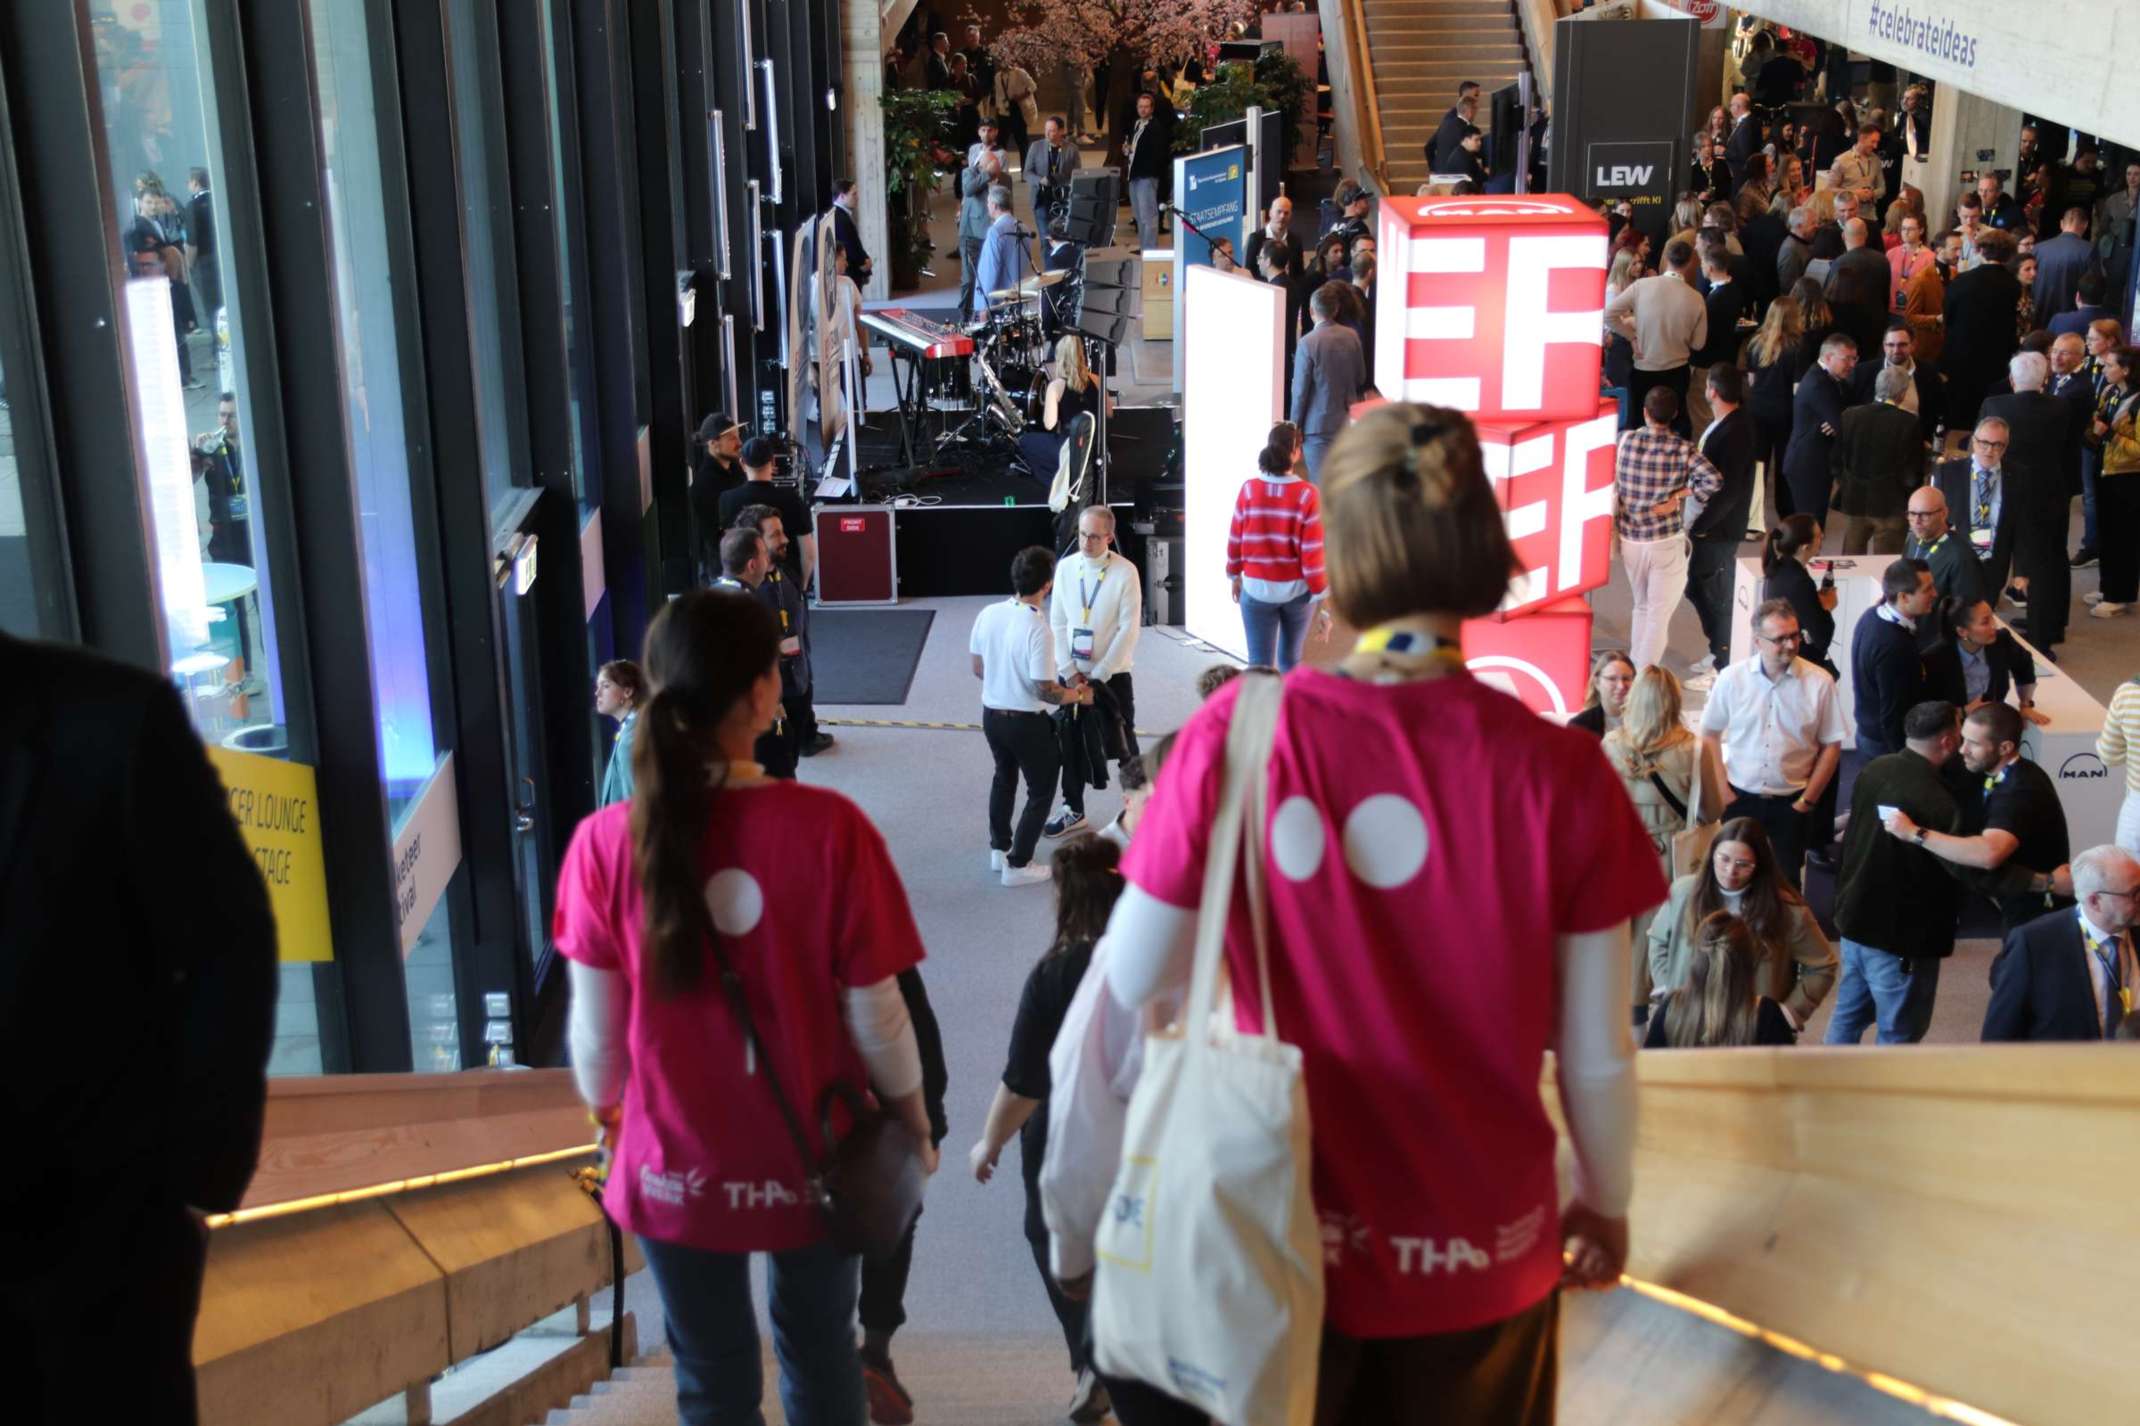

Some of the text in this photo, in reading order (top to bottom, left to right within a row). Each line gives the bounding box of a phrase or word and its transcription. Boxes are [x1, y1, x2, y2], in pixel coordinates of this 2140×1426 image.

[1869, 0, 1977, 68] #celebrateideas
[1596, 165, 1653, 186] LEW
[2062, 770, 2103, 779] MAN
[257, 793, 307, 833] LOUNGE
